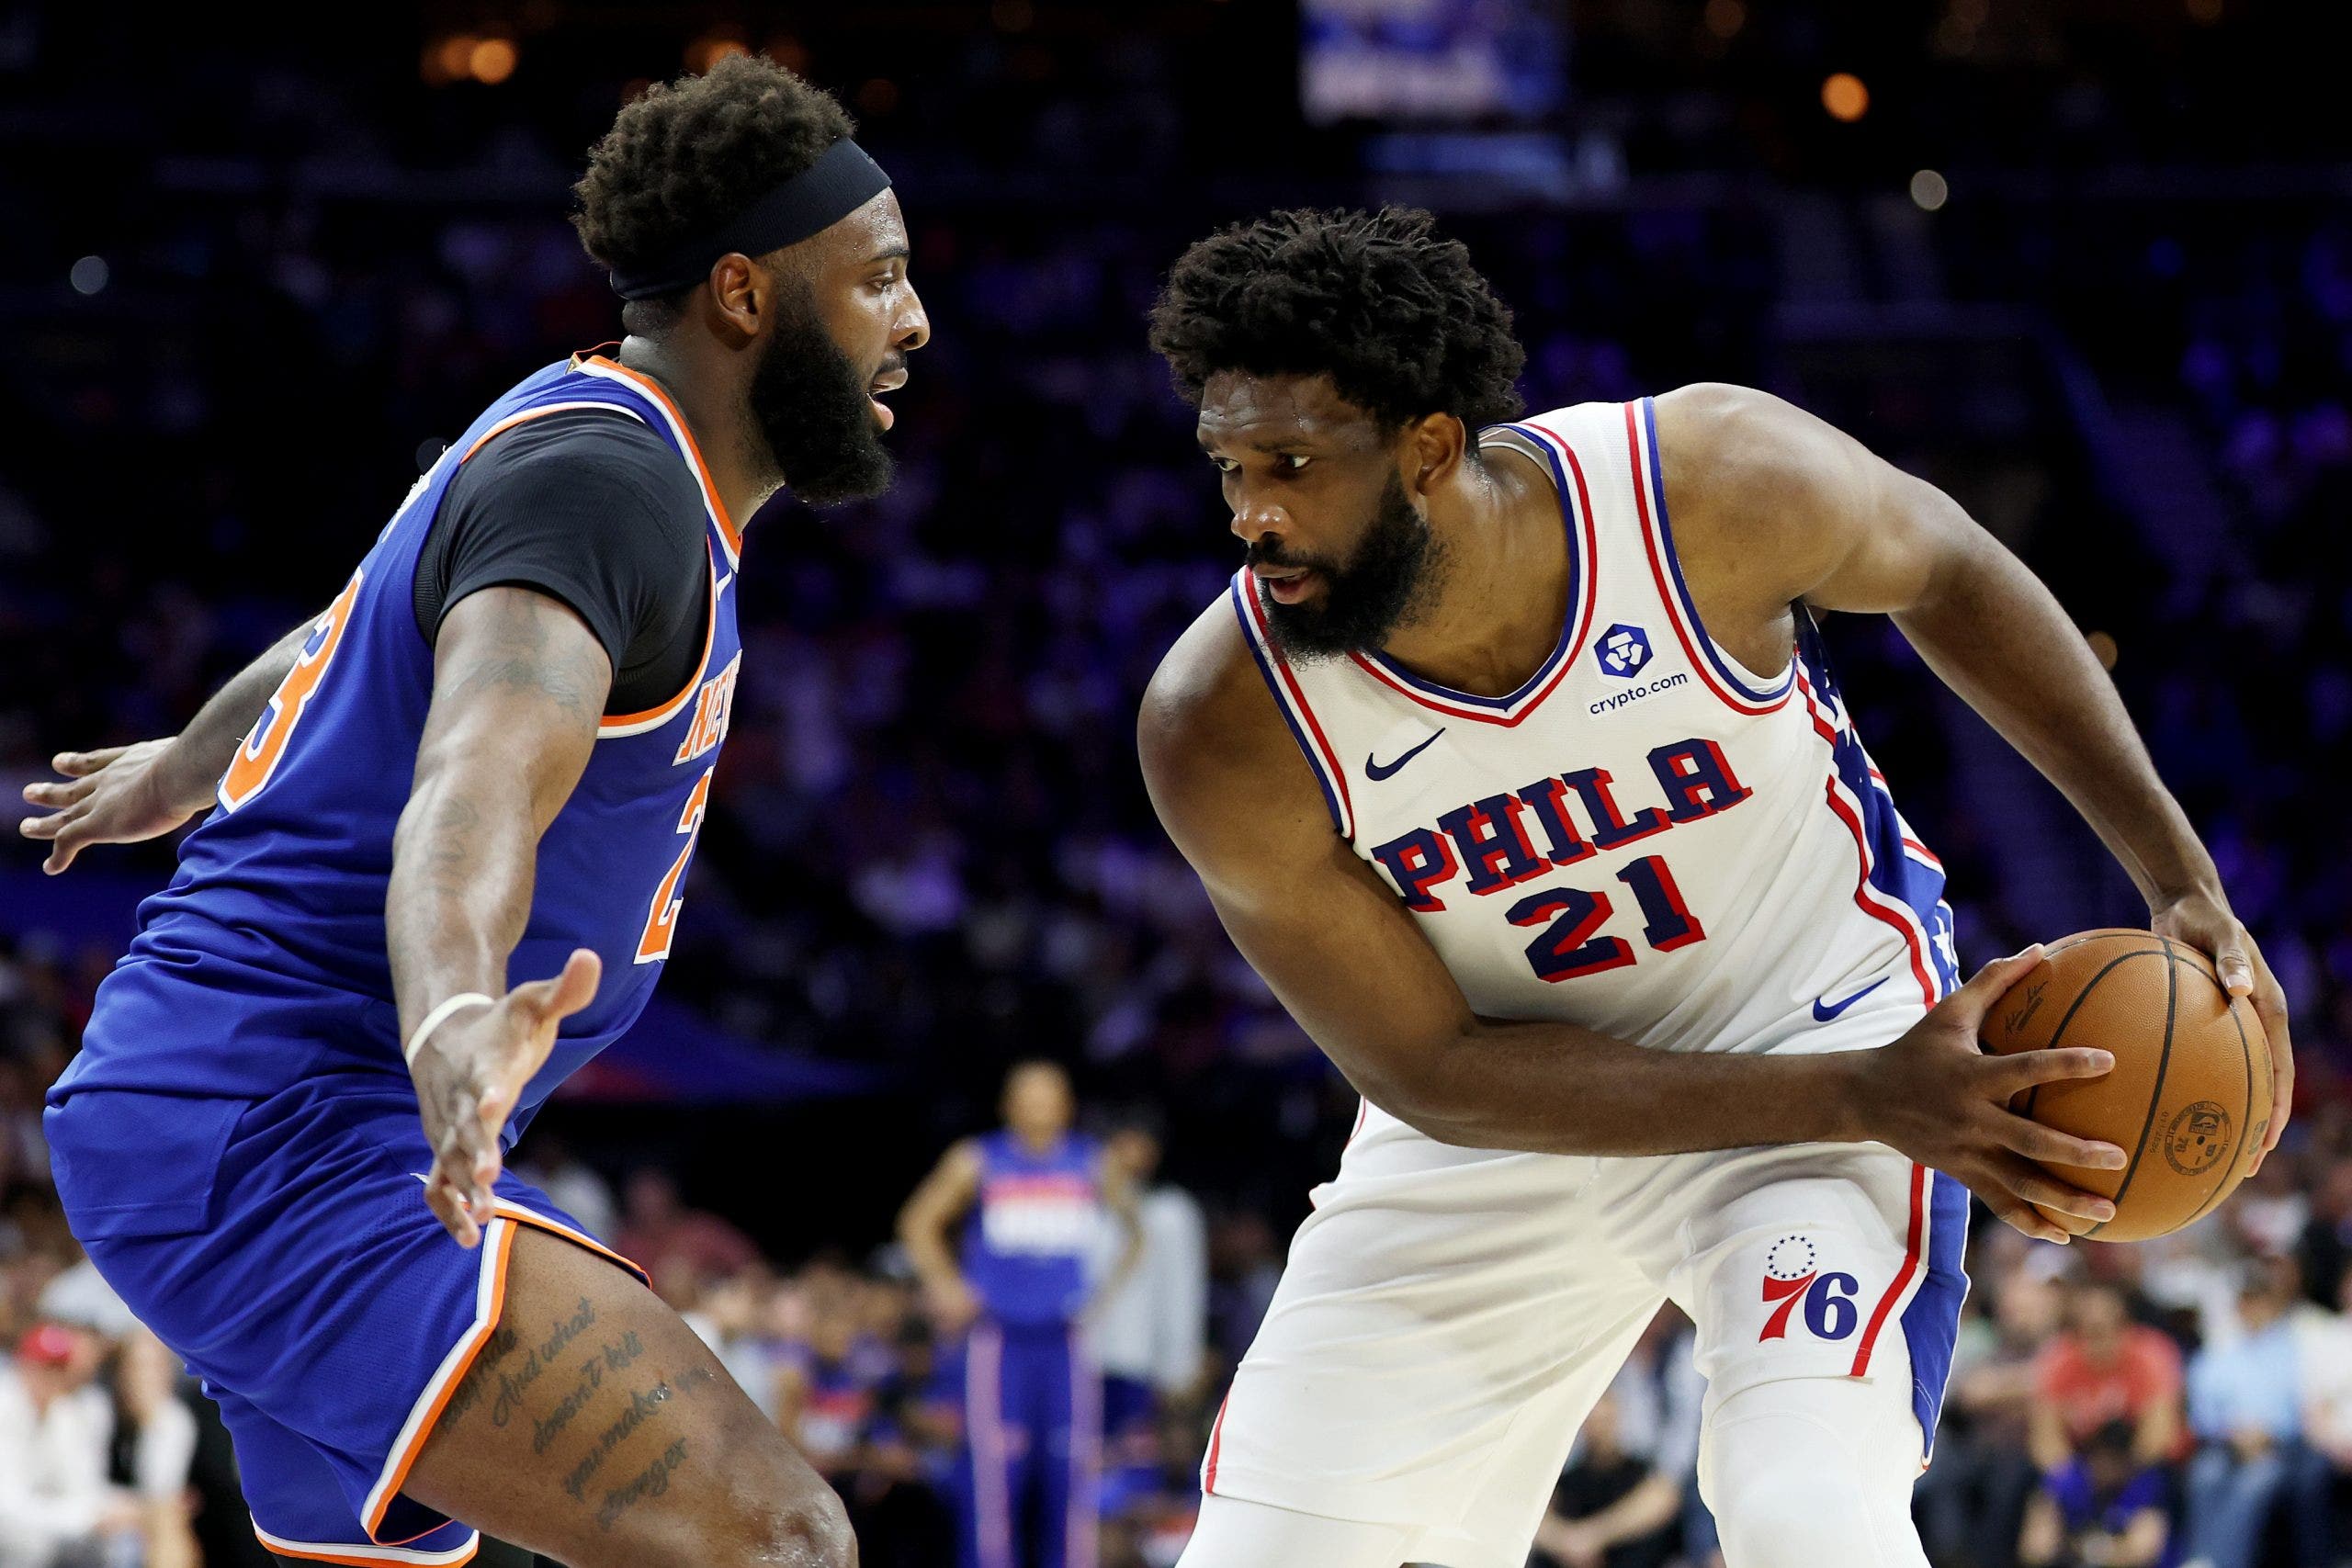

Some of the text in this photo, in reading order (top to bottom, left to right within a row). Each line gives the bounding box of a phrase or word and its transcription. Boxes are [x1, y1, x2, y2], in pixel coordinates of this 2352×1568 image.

[1589, 672, 1689, 715] crypto.com
[1370, 738, 1754, 913] PHILA
[1504, 854, 1707, 984] 21
[1758, 1269, 1860, 1343] 76
